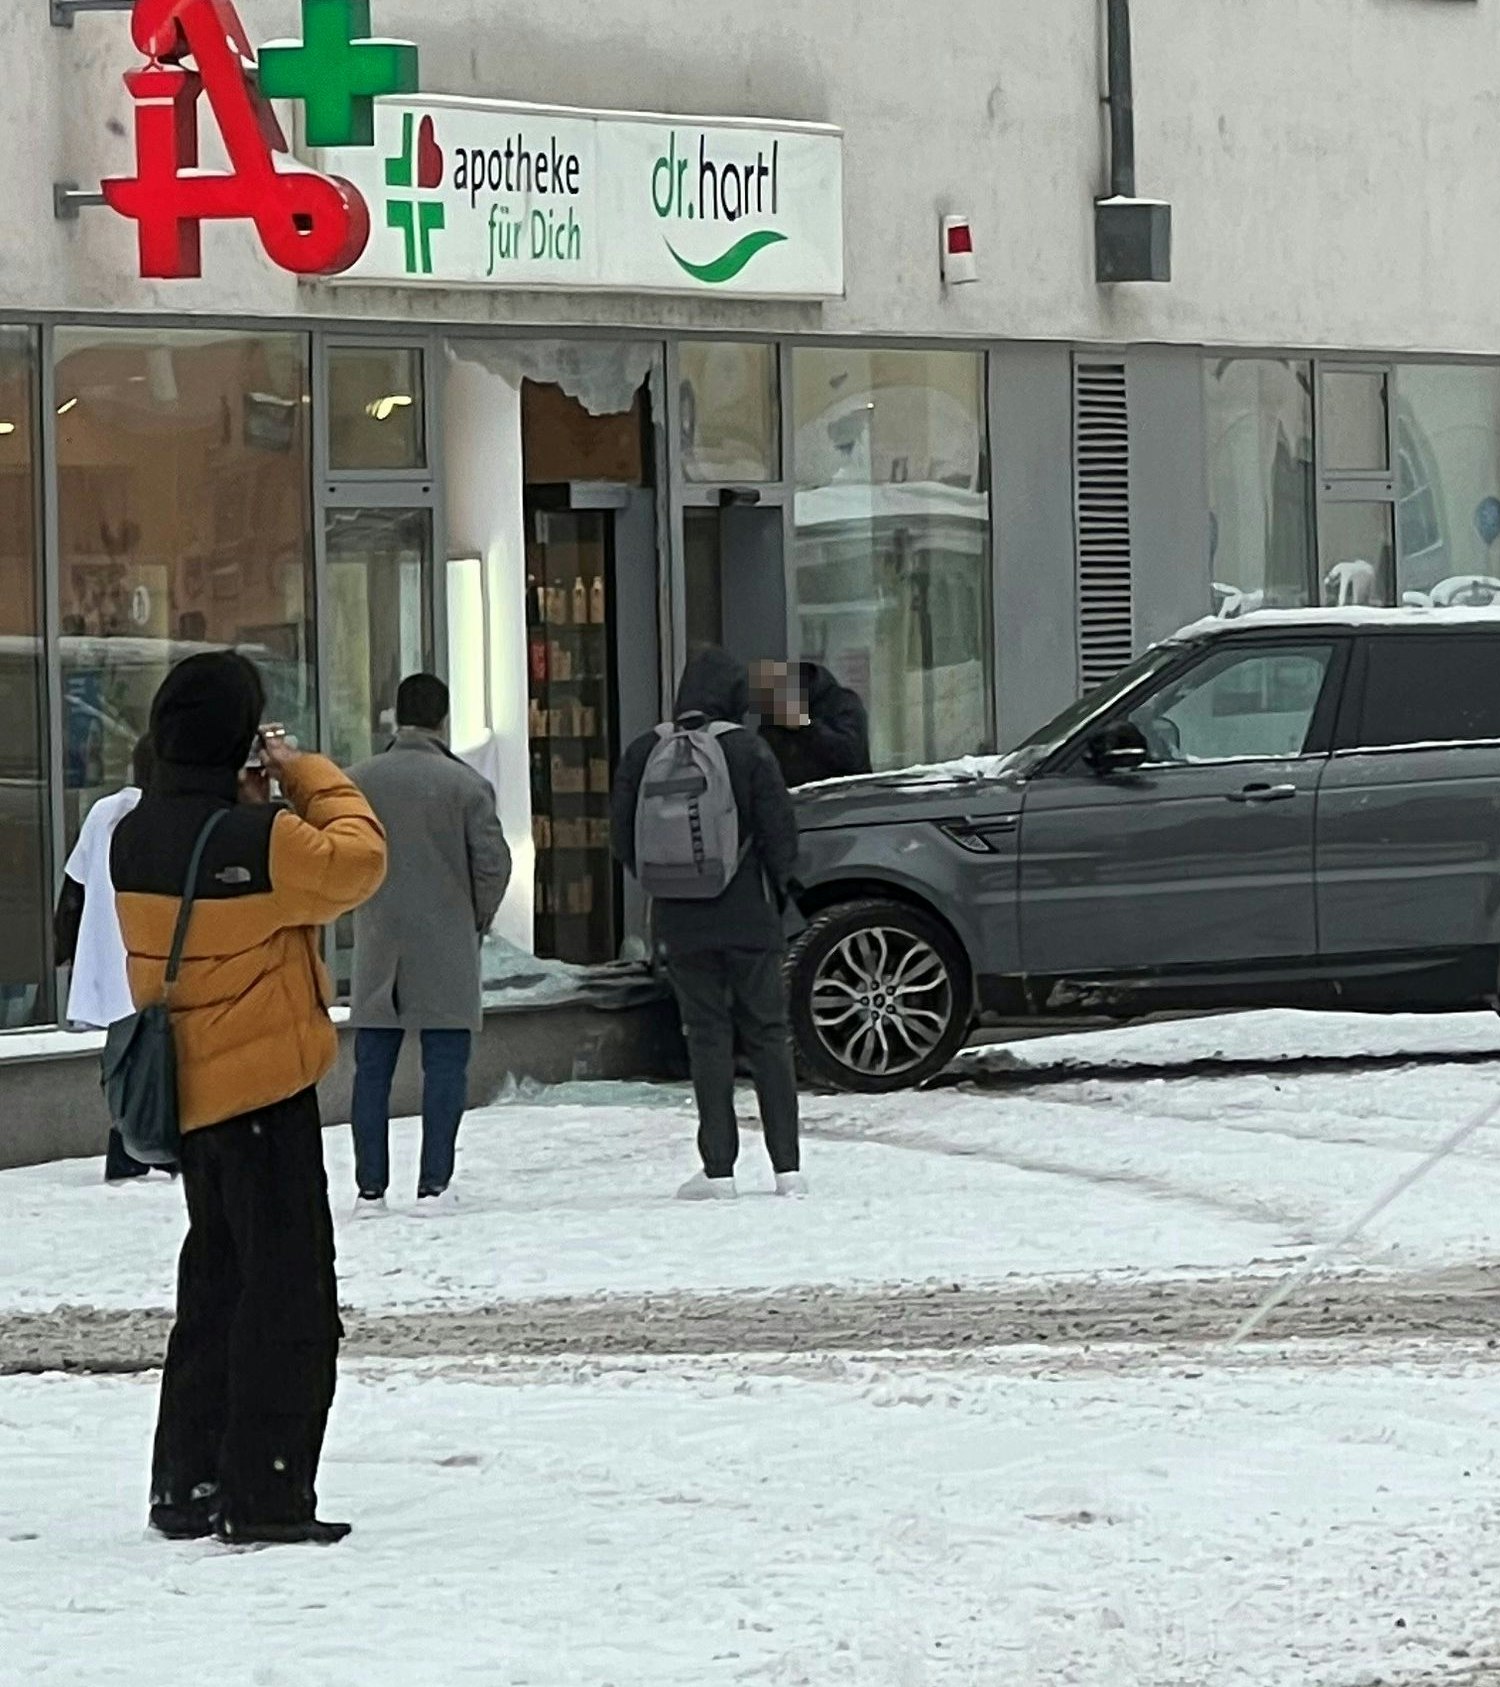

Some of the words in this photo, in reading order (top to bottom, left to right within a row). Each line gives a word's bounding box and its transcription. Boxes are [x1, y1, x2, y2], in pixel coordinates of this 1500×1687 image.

[453, 133, 580, 207] apotheke
[486, 203, 522, 276] für
[531, 206, 581, 261] Dich
